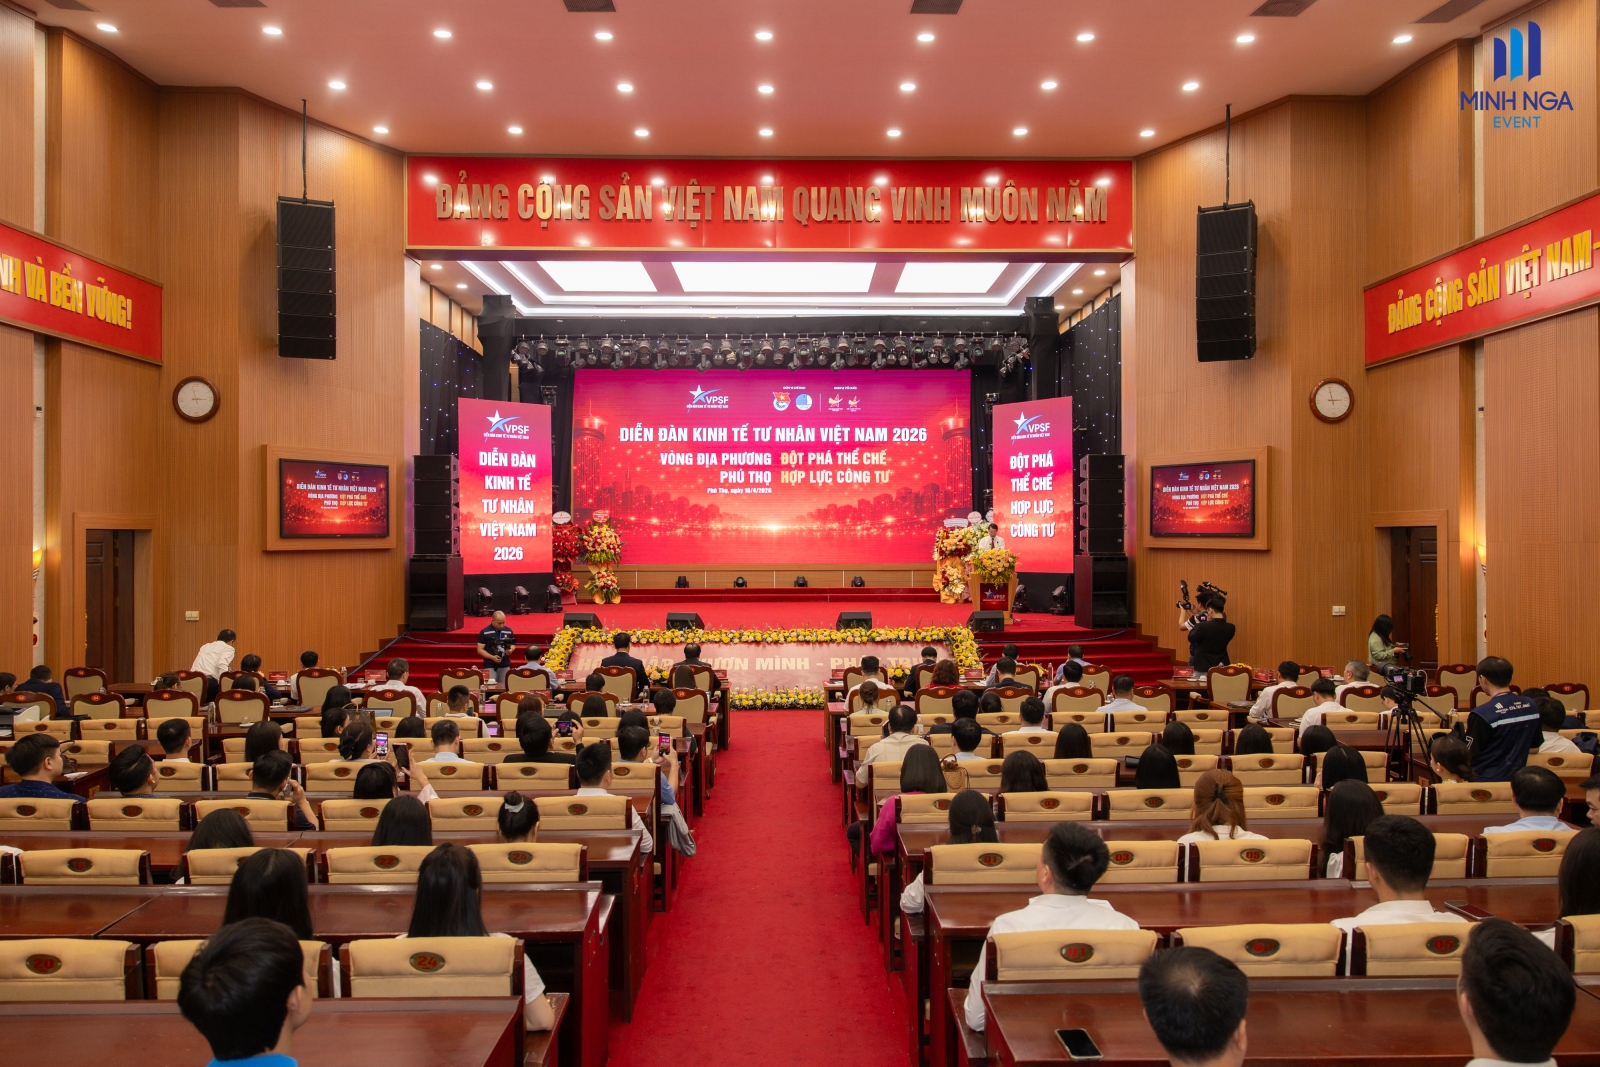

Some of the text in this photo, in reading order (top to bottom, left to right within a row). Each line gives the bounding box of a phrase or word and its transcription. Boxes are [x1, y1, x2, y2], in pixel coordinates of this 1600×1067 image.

[435, 170, 1108, 228] ĐẢNG CỘNG SẢN VIỆT NAM QUANG VINH MUÔN NĂM
[1388, 229, 1593, 334] ĐẢNG CỘNG SẢN VIỆT NAM
[24, 255, 48, 303] VÀ
[50, 263, 83, 314] BỀN
[85, 277, 133, 330] VỮNG!
[705, 396, 729, 404] VPSF
[504, 424, 529, 434] VPSF
[619, 422, 927, 444] DIỄN ĐÀN KINH TẾ TƯ NHÂN VIỆT NAM 2026
[1028, 422, 1050, 433] VPSF
[479, 447, 536, 468] DIỄN ĐÀN
[660, 450, 772, 468] VÒNG ĐỊA PHƯƠNG
[780, 447, 887, 467] ĐỘT PHÁ THỂ CHẾ
[1010, 450, 1054, 472] ĐỘT PHÁ
[485, 472, 532, 491] KINH TẾ
[720, 468, 772, 485] PHÚ THỌ
[780, 468, 890, 486] HỢP LỰC CÔNG TƯ
[1011, 472, 1054, 492] THỂ CHẾ
[482, 497, 534, 514] TƯ NHÂN
[1010, 499, 1054, 517] HỢP LỰC
[480, 520, 537, 540] VIỆT NAM
[1010, 521, 1056, 538] CÔNG TƯ
[494, 546, 523, 561] 2026
[756, 655, 810, 671] MÌNH
[513, 853, 527, 861] 24
[984, 855, 997, 863] 01
[1115, 853, 1130, 861] 03
[1068, 947, 1086, 957] 01
[1253, 942, 1273, 952] 03
[1433, 939, 1454, 950] 05
[33, 958, 54, 969] 20
[418, 956, 438, 967] 24
